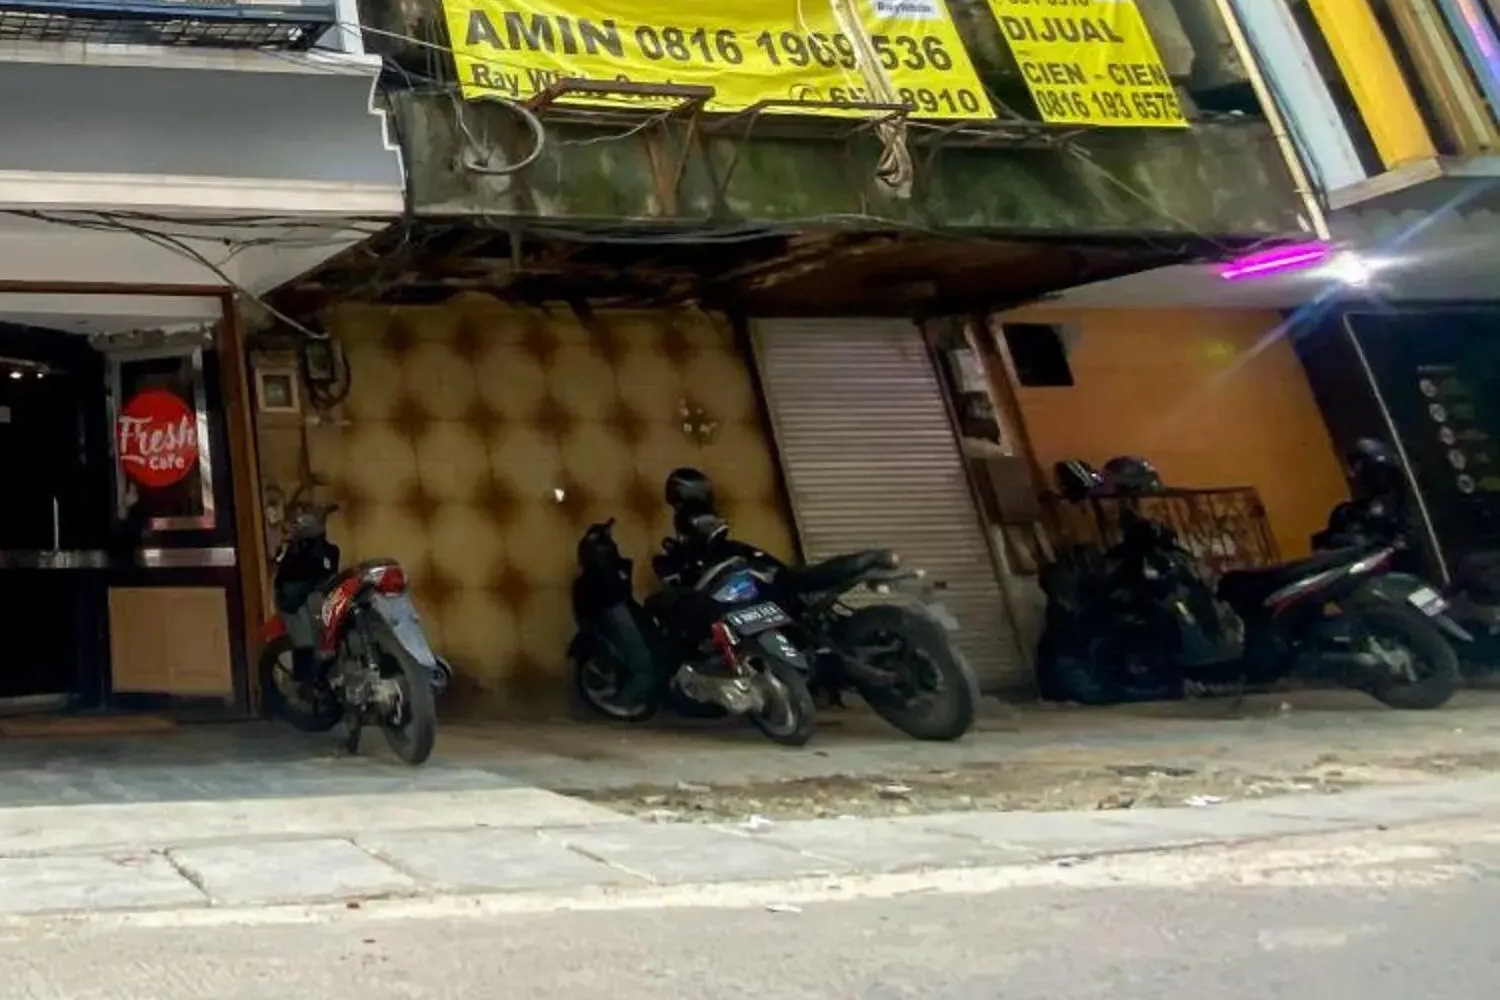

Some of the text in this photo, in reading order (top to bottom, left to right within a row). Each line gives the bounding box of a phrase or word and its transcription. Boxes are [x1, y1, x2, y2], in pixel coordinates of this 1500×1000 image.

[466, 9, 624, 57] AMIN
[635, 25, 743, 64] 0816
[1000, 15, 1124, 43] DIJUAL
[471, 63, 519, 96] Ray
[1023, 61, 1088, 85] CIEN
[1107, 63, 1169, 87] CIEN
[898, 87, 980, 113] 8910
[1035, 89, 1090, 119] 0816
[118, 415, 197, 456] Fresh
